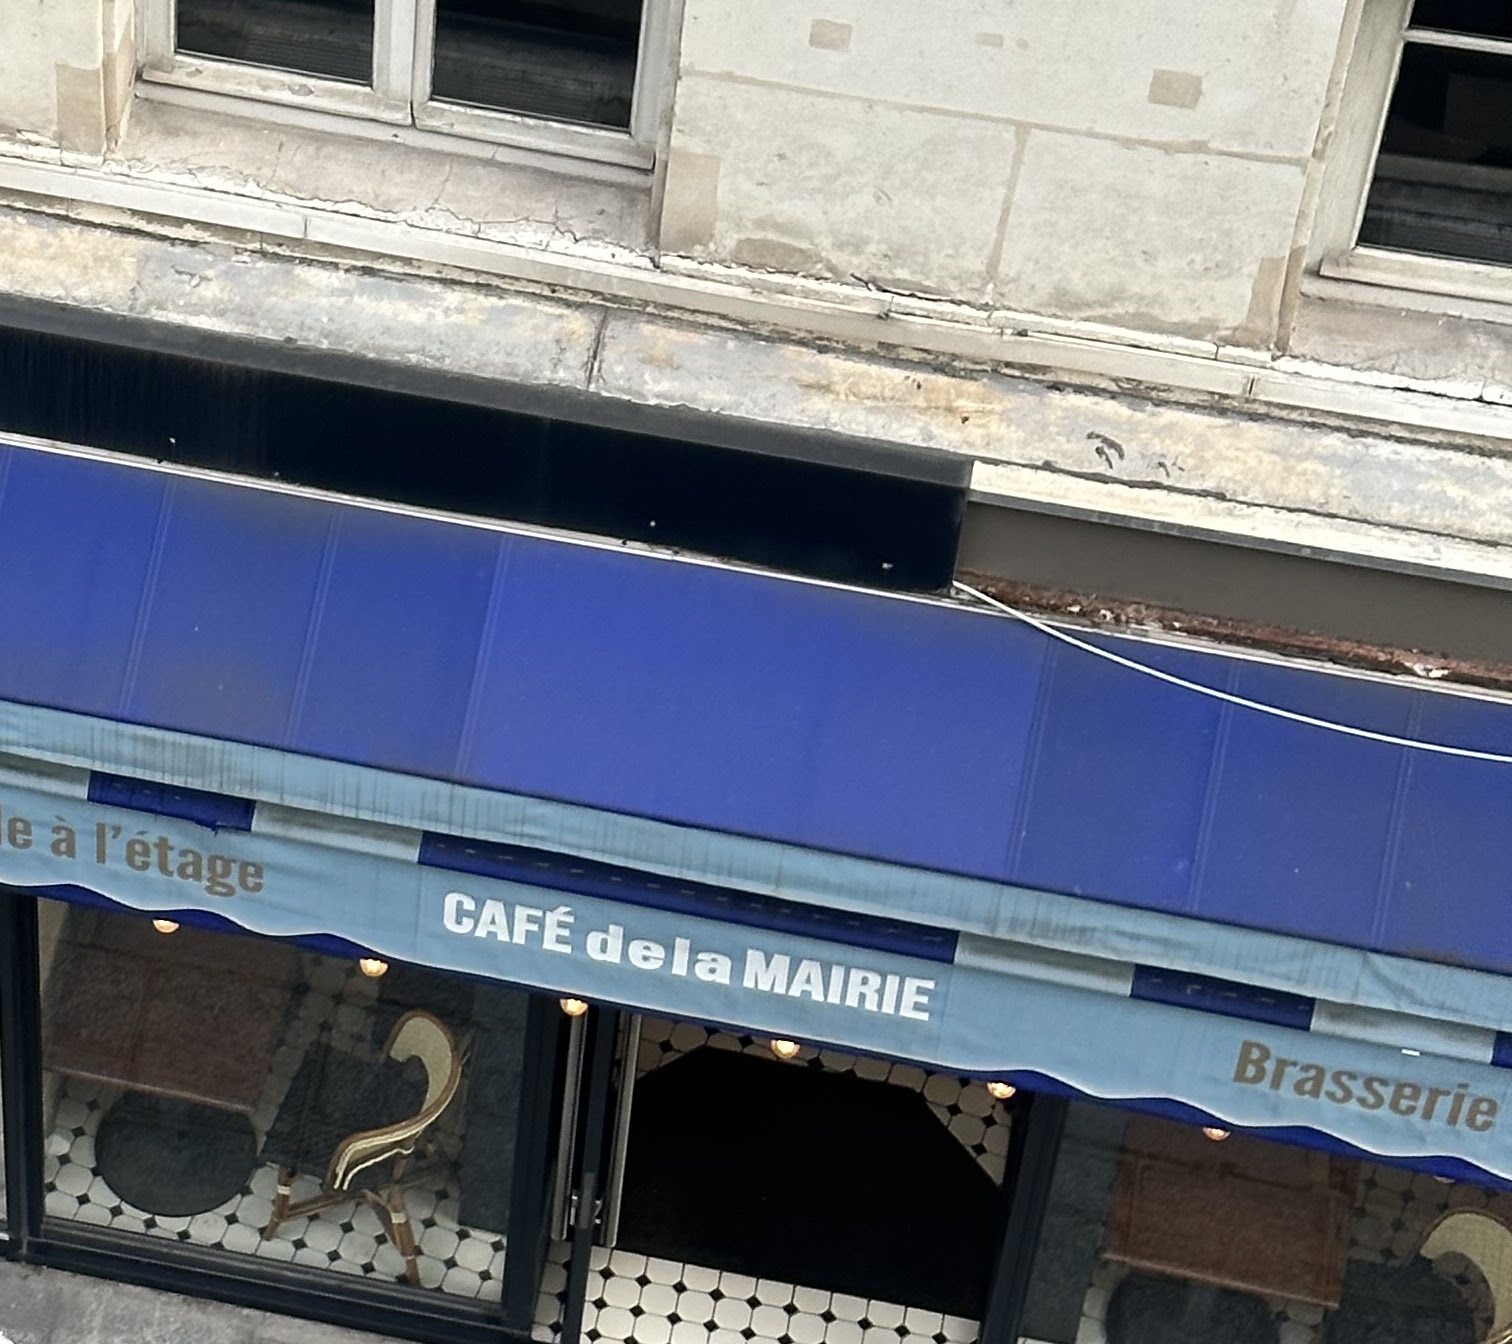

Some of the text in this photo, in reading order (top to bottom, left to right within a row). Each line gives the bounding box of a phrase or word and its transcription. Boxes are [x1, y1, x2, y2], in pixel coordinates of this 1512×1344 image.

[50, 815, 77, 860] à
[95, 822, 265, 898] l'étage
[442, 891, 576, 955] CAFÉ
[742, 947, 937, 1022] MAIRIE
[1232, 1039, 1501, 1133] Brasserie
